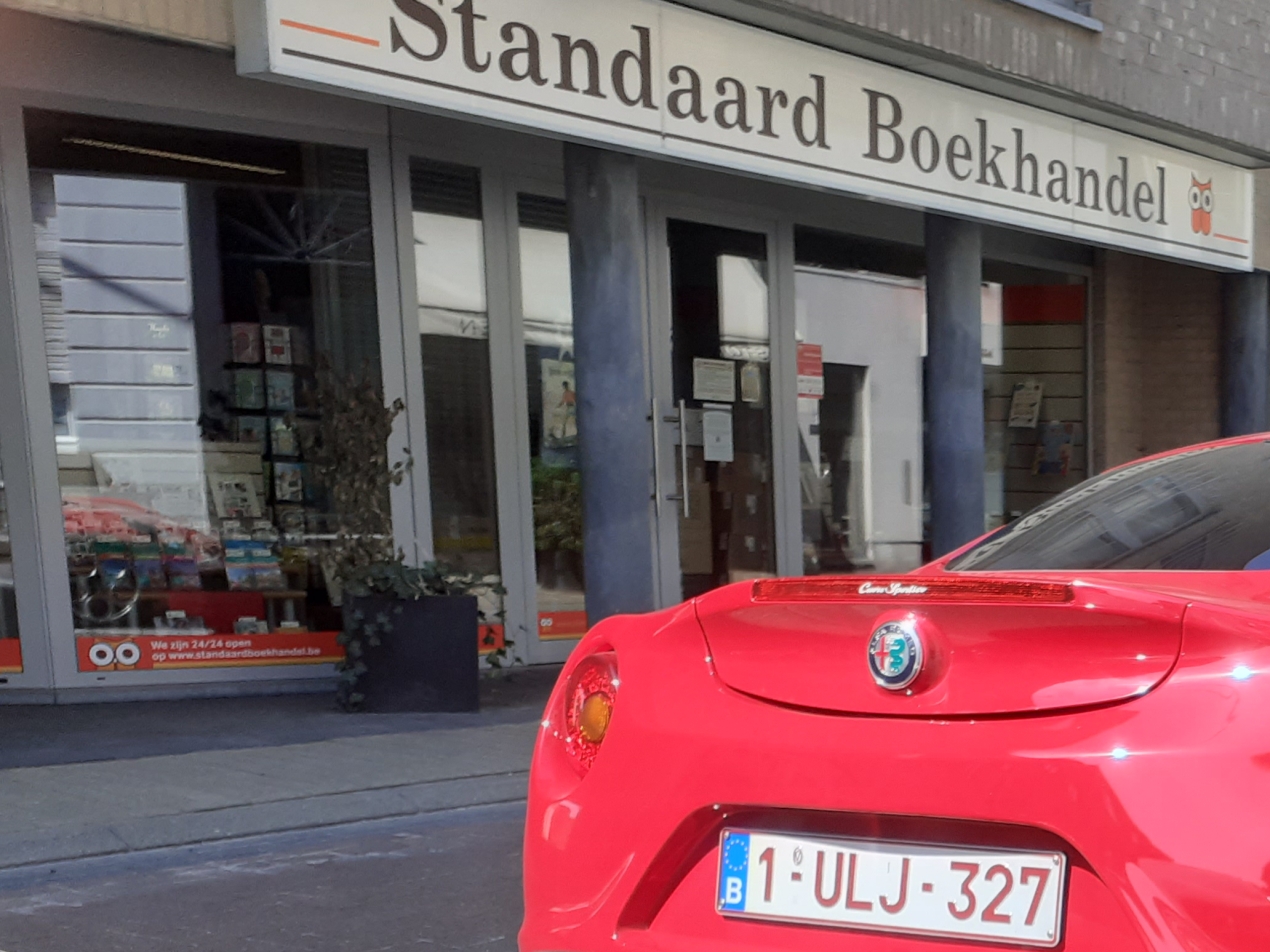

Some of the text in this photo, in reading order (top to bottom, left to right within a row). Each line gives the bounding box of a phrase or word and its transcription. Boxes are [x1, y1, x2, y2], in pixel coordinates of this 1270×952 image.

[389, 0, 1169, 226] Standaard Boekhandel
[151, 639, 252, 651] We zijn 24/24 open
[152, 647, 321, 662] op www.standaardboekhandel.be
[725, 877, 743, 905] B
[758, 845, 1052, 926] 1-ULJ-327
